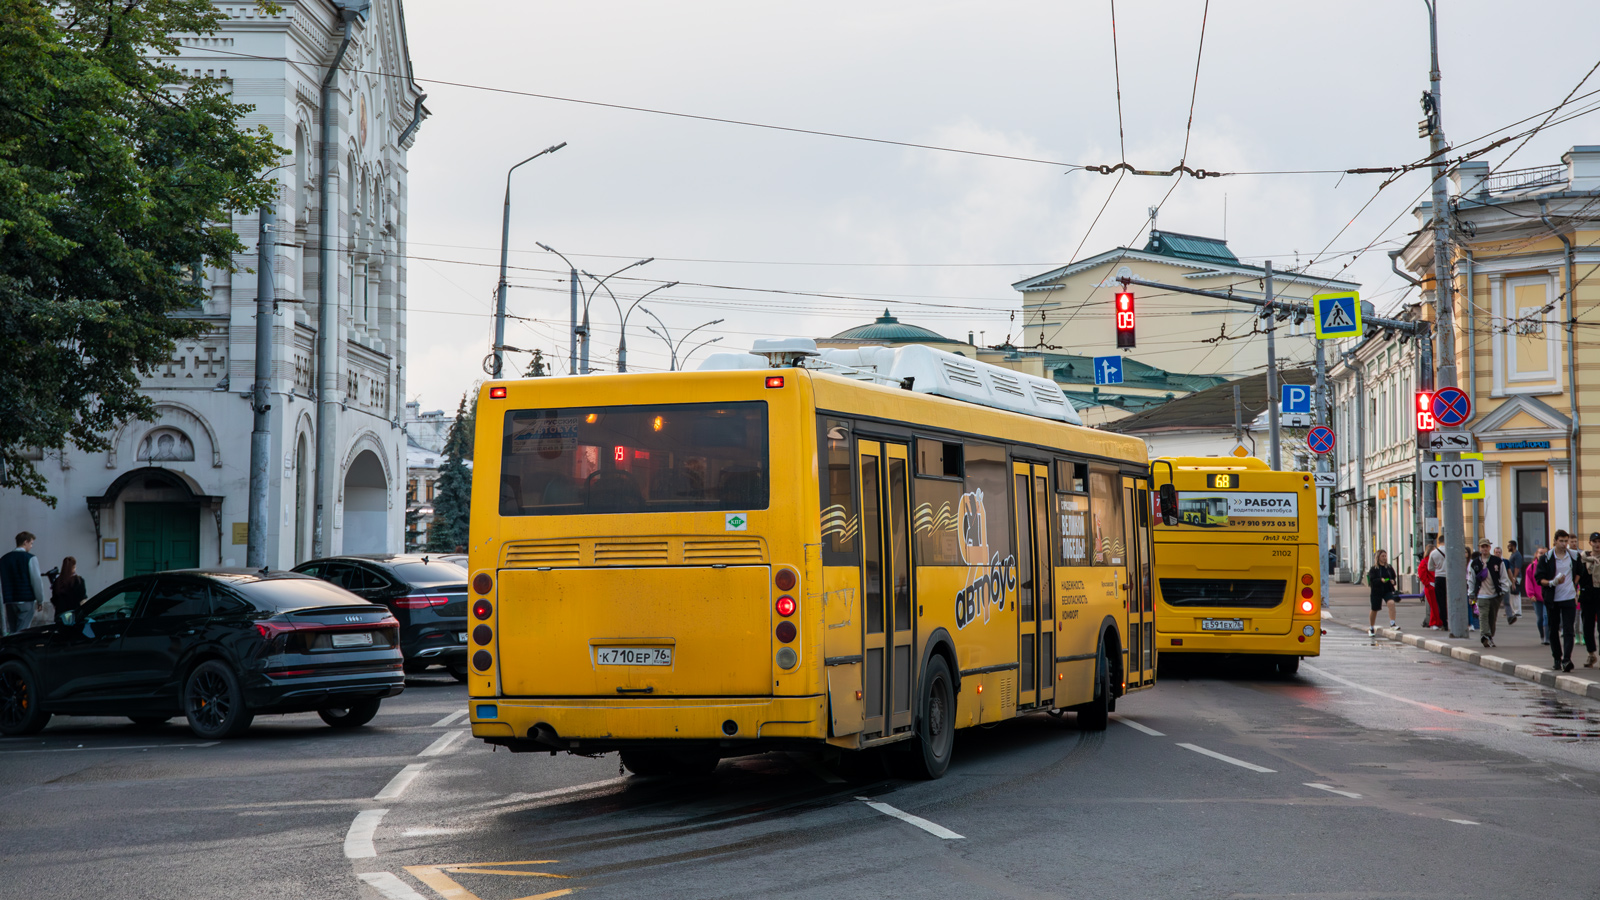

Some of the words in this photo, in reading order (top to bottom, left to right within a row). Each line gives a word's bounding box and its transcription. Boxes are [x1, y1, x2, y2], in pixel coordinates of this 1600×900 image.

[1118, 312, 1134, 328] 09
[1290, 388, 1306, 410] P
[1417, 412, 1435, 429] 09
[1429, 464, 1475, 478] СТОП
[1215, 474, 1230, 488] 68
[1244, 498, 1291, 507] РАБОТА
[654, 649, 668, 660] 76
